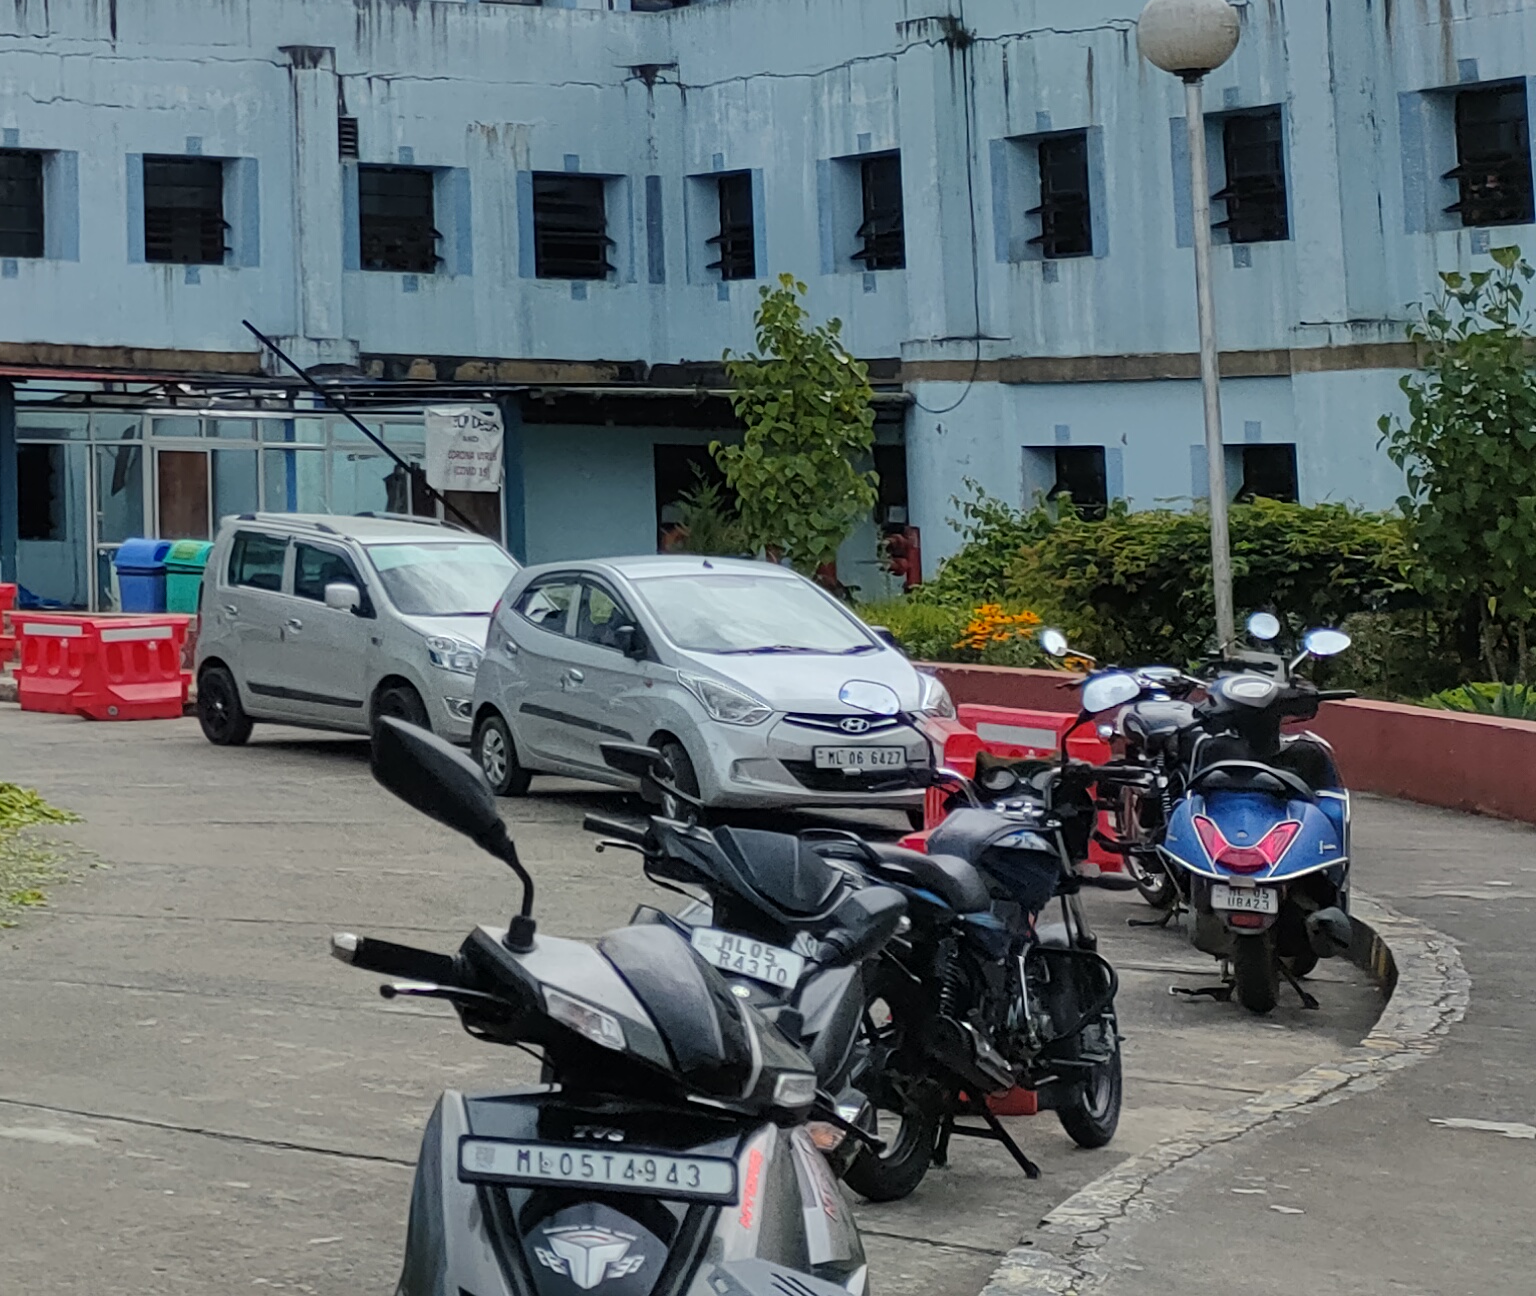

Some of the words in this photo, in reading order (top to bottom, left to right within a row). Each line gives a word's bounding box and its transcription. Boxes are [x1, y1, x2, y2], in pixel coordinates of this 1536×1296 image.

[828, 751, 843, 765] ML
[849, 751, 864, 765] 06
[871, 751, 901, 765] 6427
[719, 935, 777, 962] ML05
[517, 1149, 701, 1188] ML05T4943
